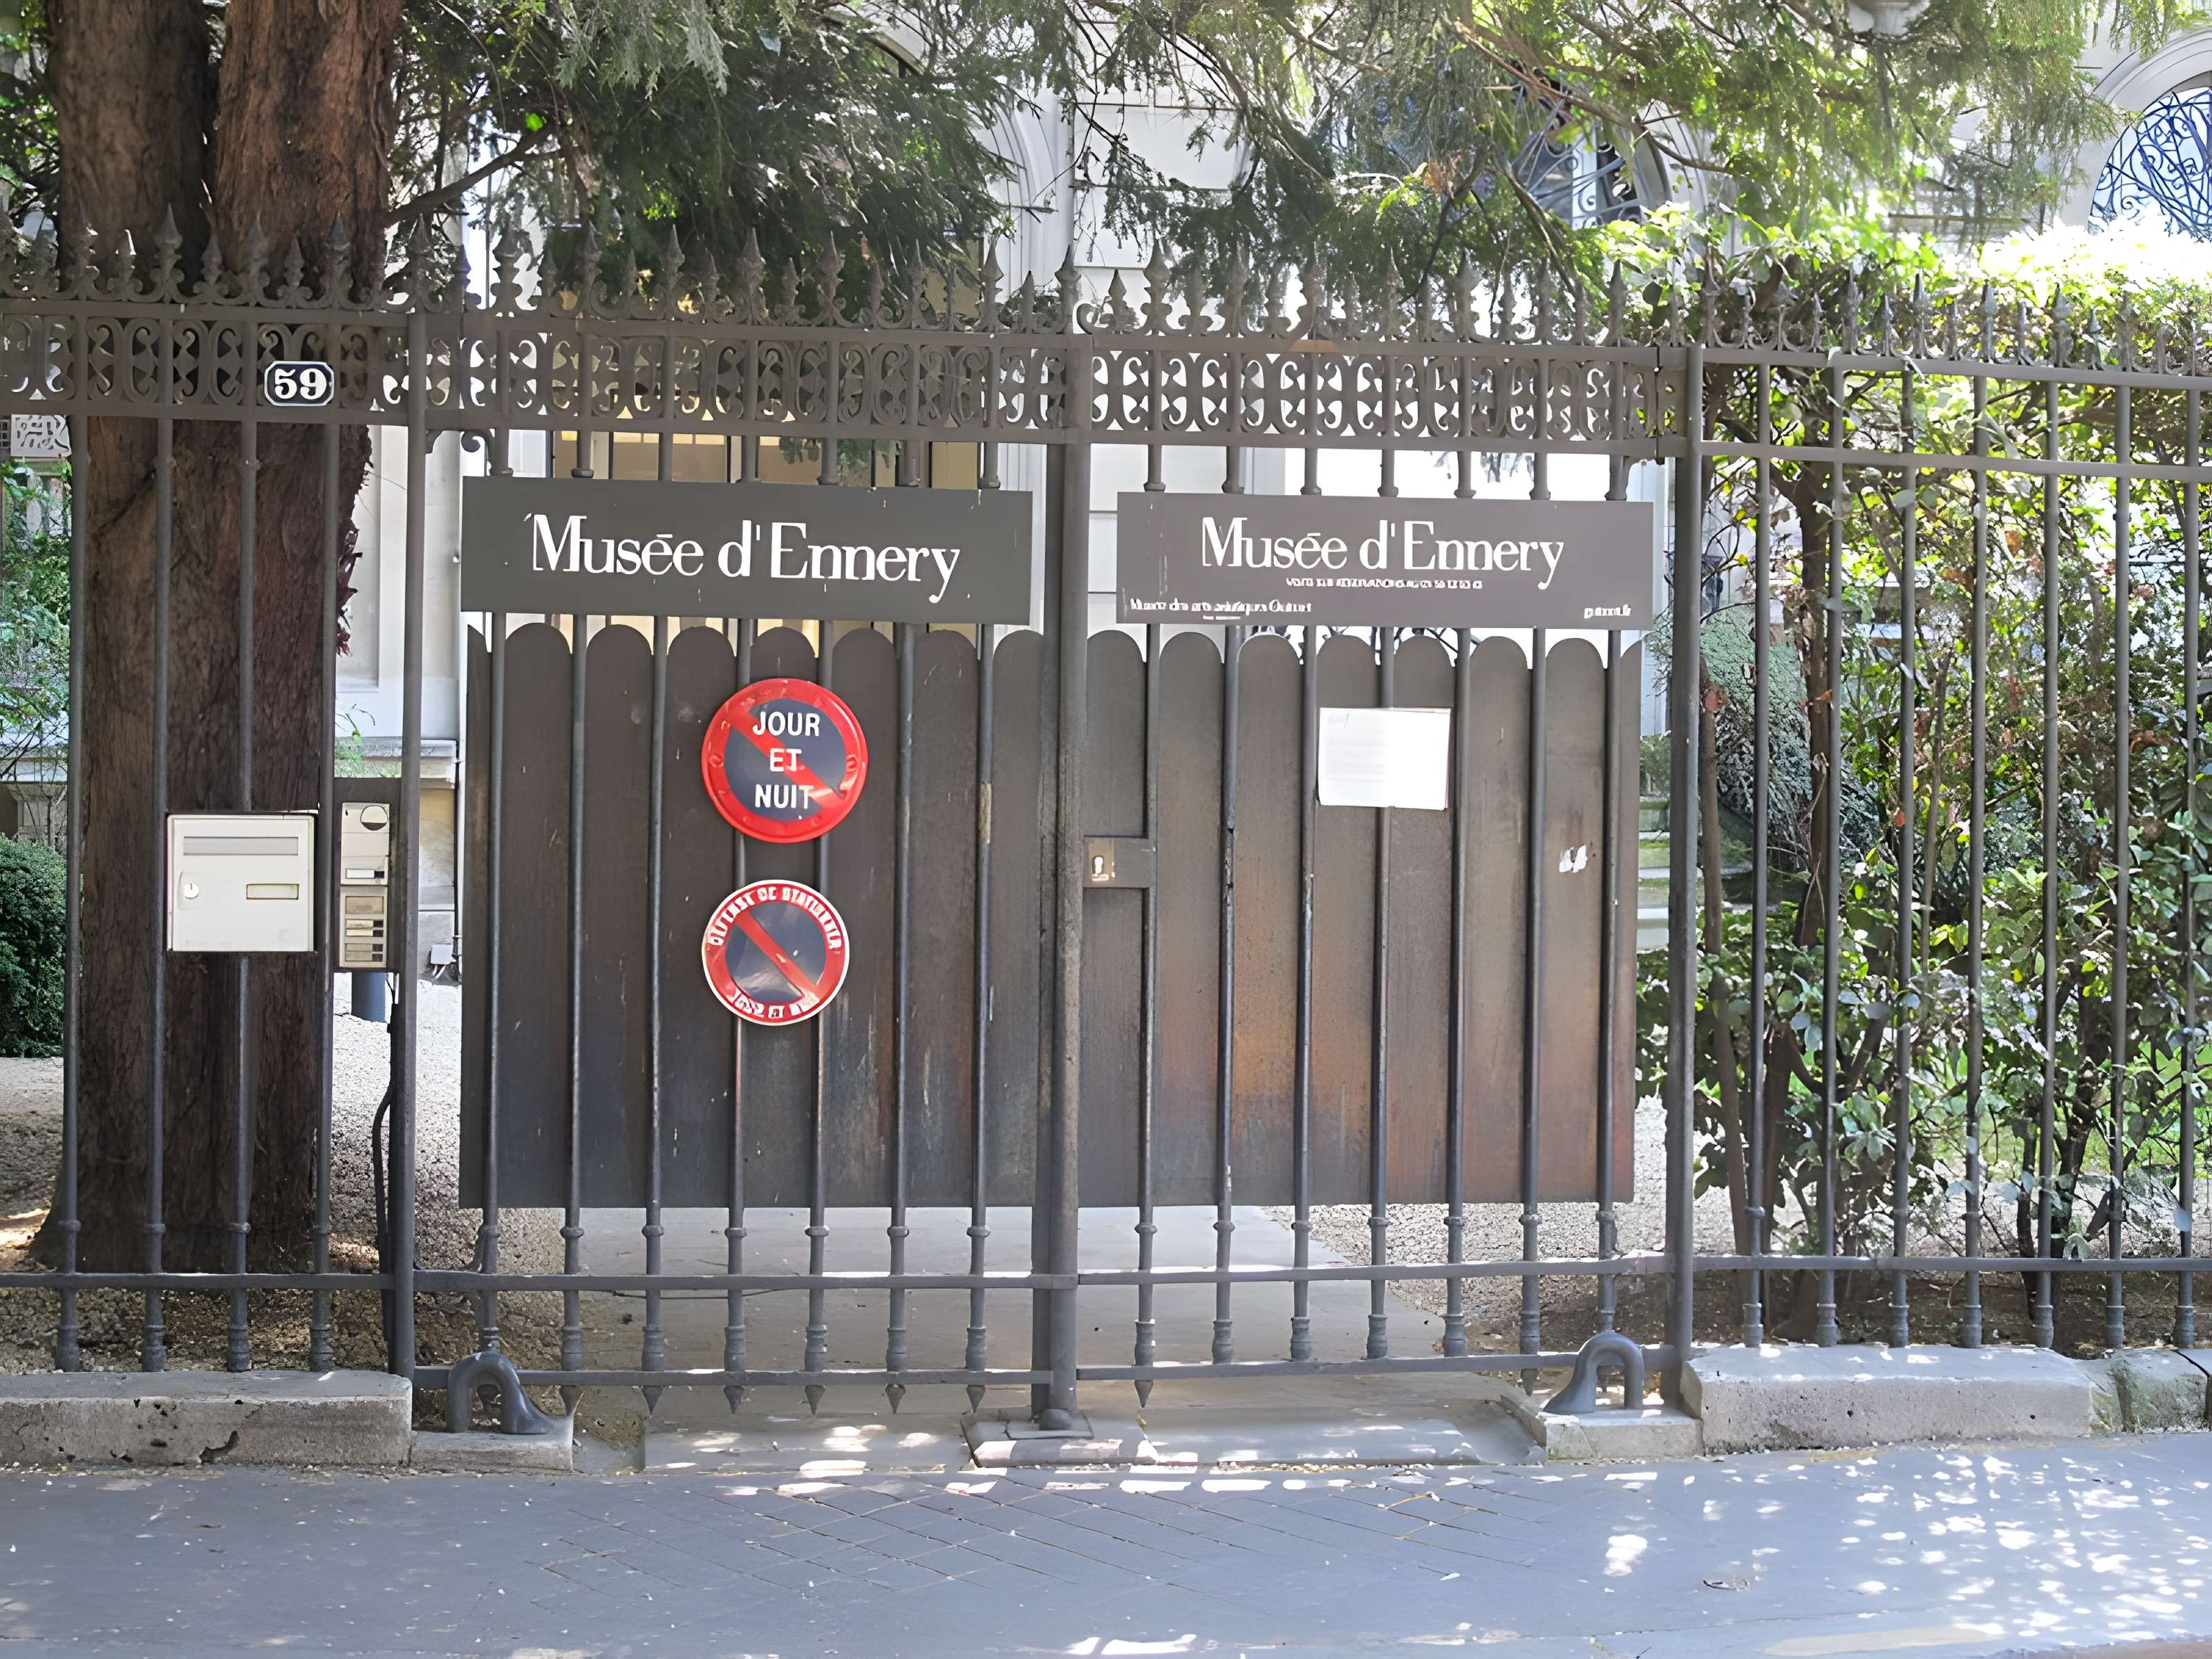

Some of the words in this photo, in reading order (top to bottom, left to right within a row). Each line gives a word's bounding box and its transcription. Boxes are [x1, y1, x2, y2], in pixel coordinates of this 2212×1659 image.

[274, 368, 327, 400] 59
[532, 514, 704, 577] Musée
[718, 519, 961, 603] d'Ennery
[1202, 516, 1348, 570] Musée
[1359, 519, 1564, 590] d'Ennery
[752, 711, 821, 737] JOUR
[769, 748, 803, 772] ET
[754, 783, 814, 809] NUIT
